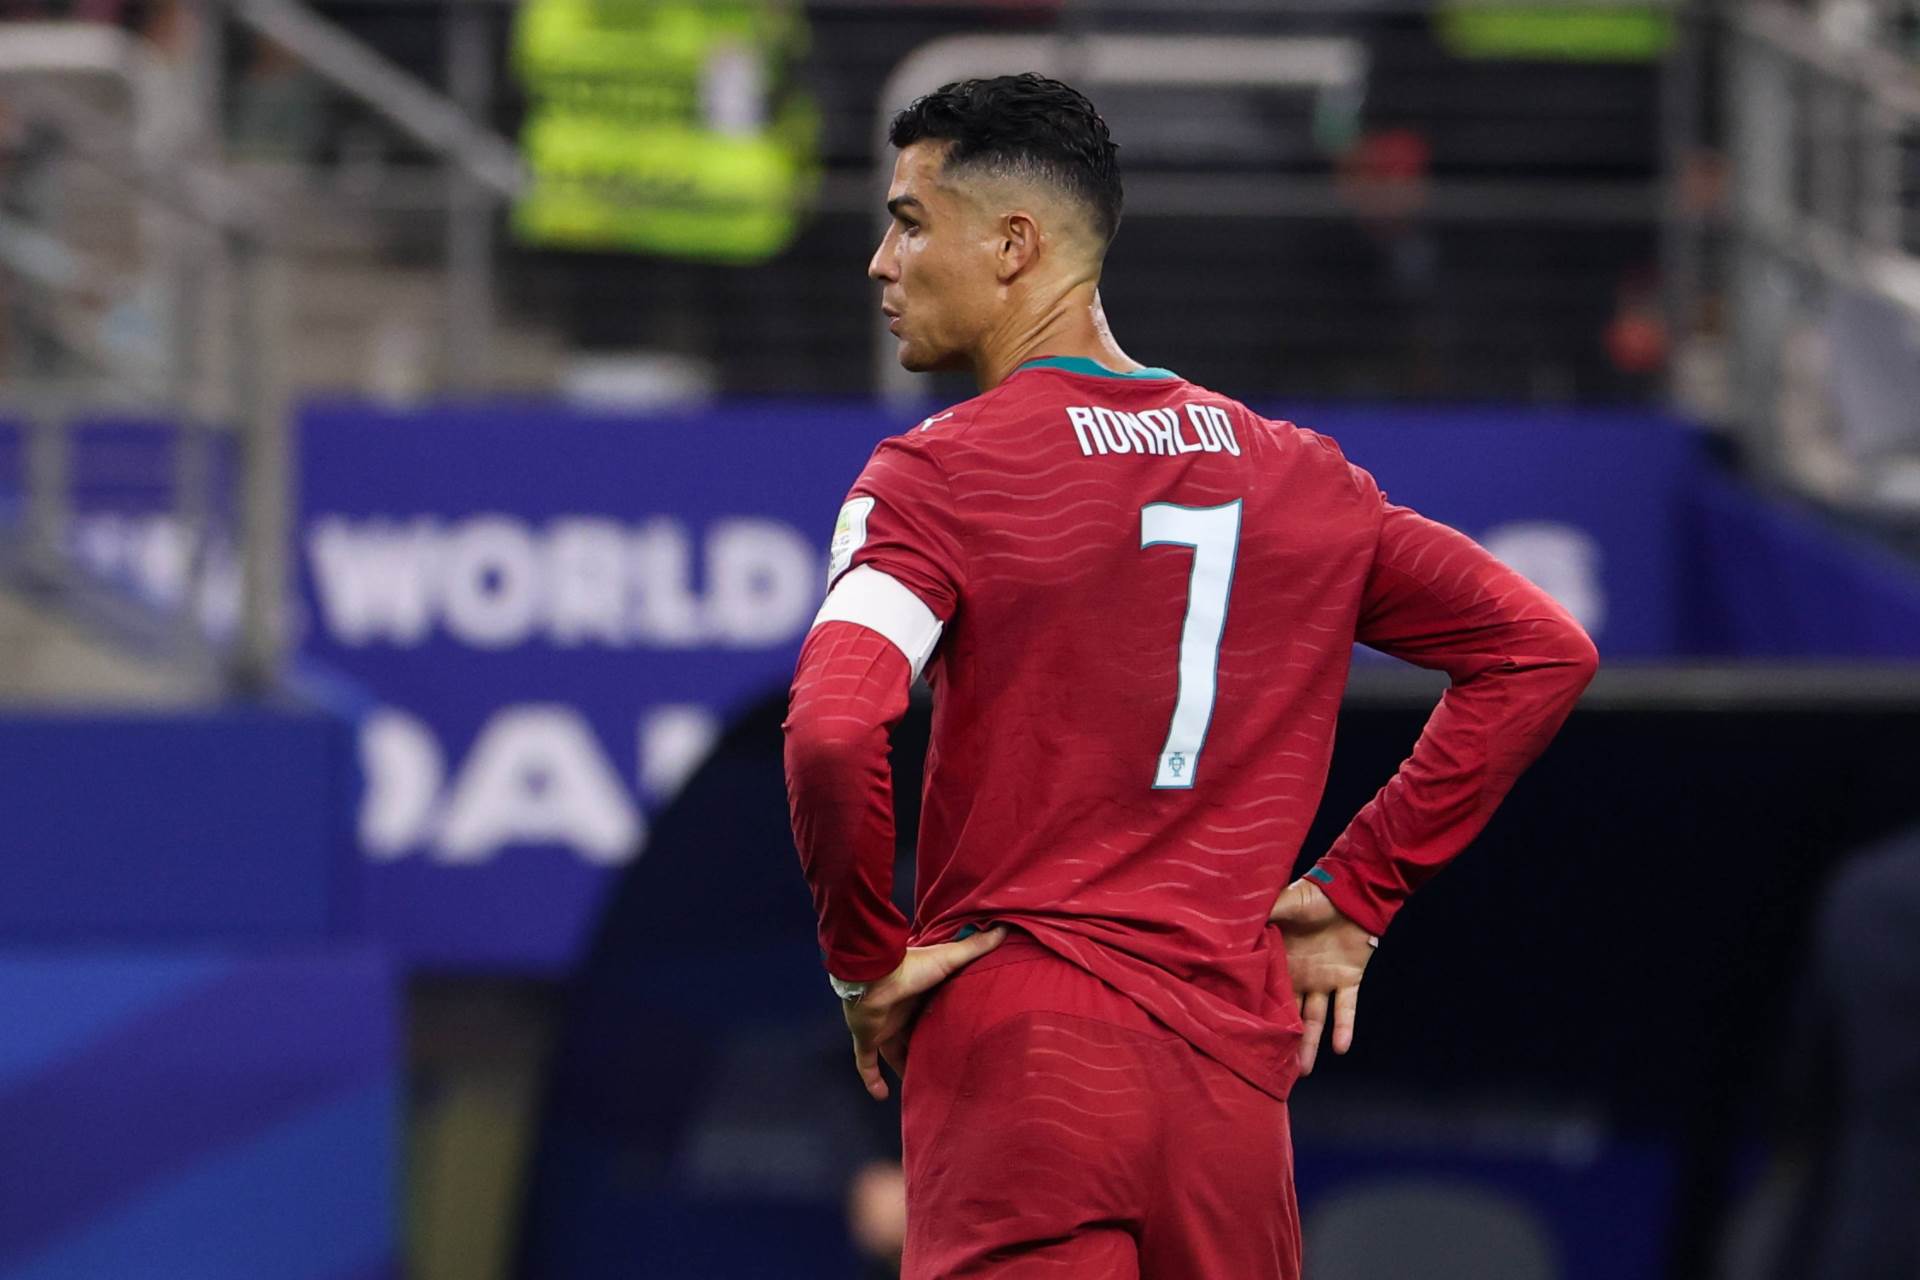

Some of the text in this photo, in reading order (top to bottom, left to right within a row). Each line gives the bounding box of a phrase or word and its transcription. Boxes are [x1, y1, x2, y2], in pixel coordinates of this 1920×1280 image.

[1065, 403, 1241, 457] RONALDO
[308, 514, 818, 648] WORLD
[1141, 498, 1243, 789] 7
